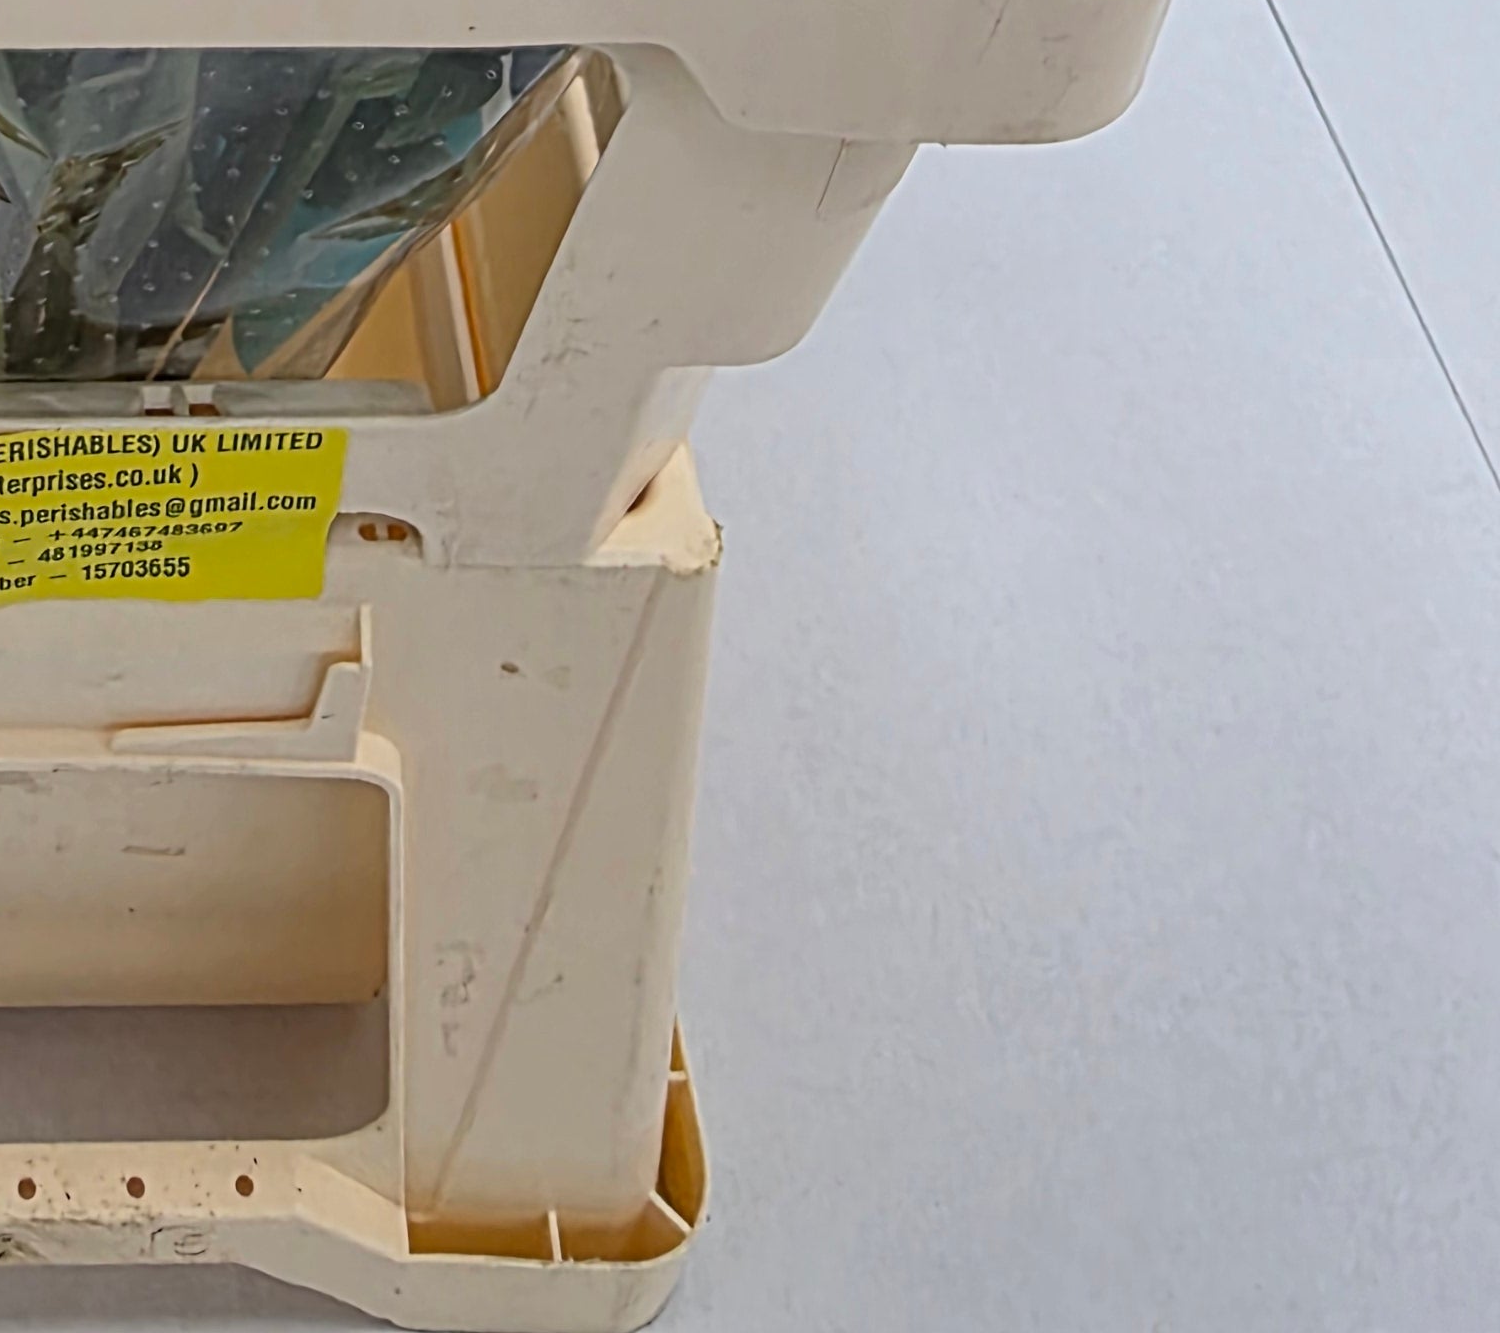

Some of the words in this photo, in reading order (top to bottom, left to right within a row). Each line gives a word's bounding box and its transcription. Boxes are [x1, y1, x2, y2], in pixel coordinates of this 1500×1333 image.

[173, 433, 206, 453] UK
[217, 433, 323, 452] LIMITED
[190, 464, 198, 488] )
[82, 557, 190, 580] 15703655
